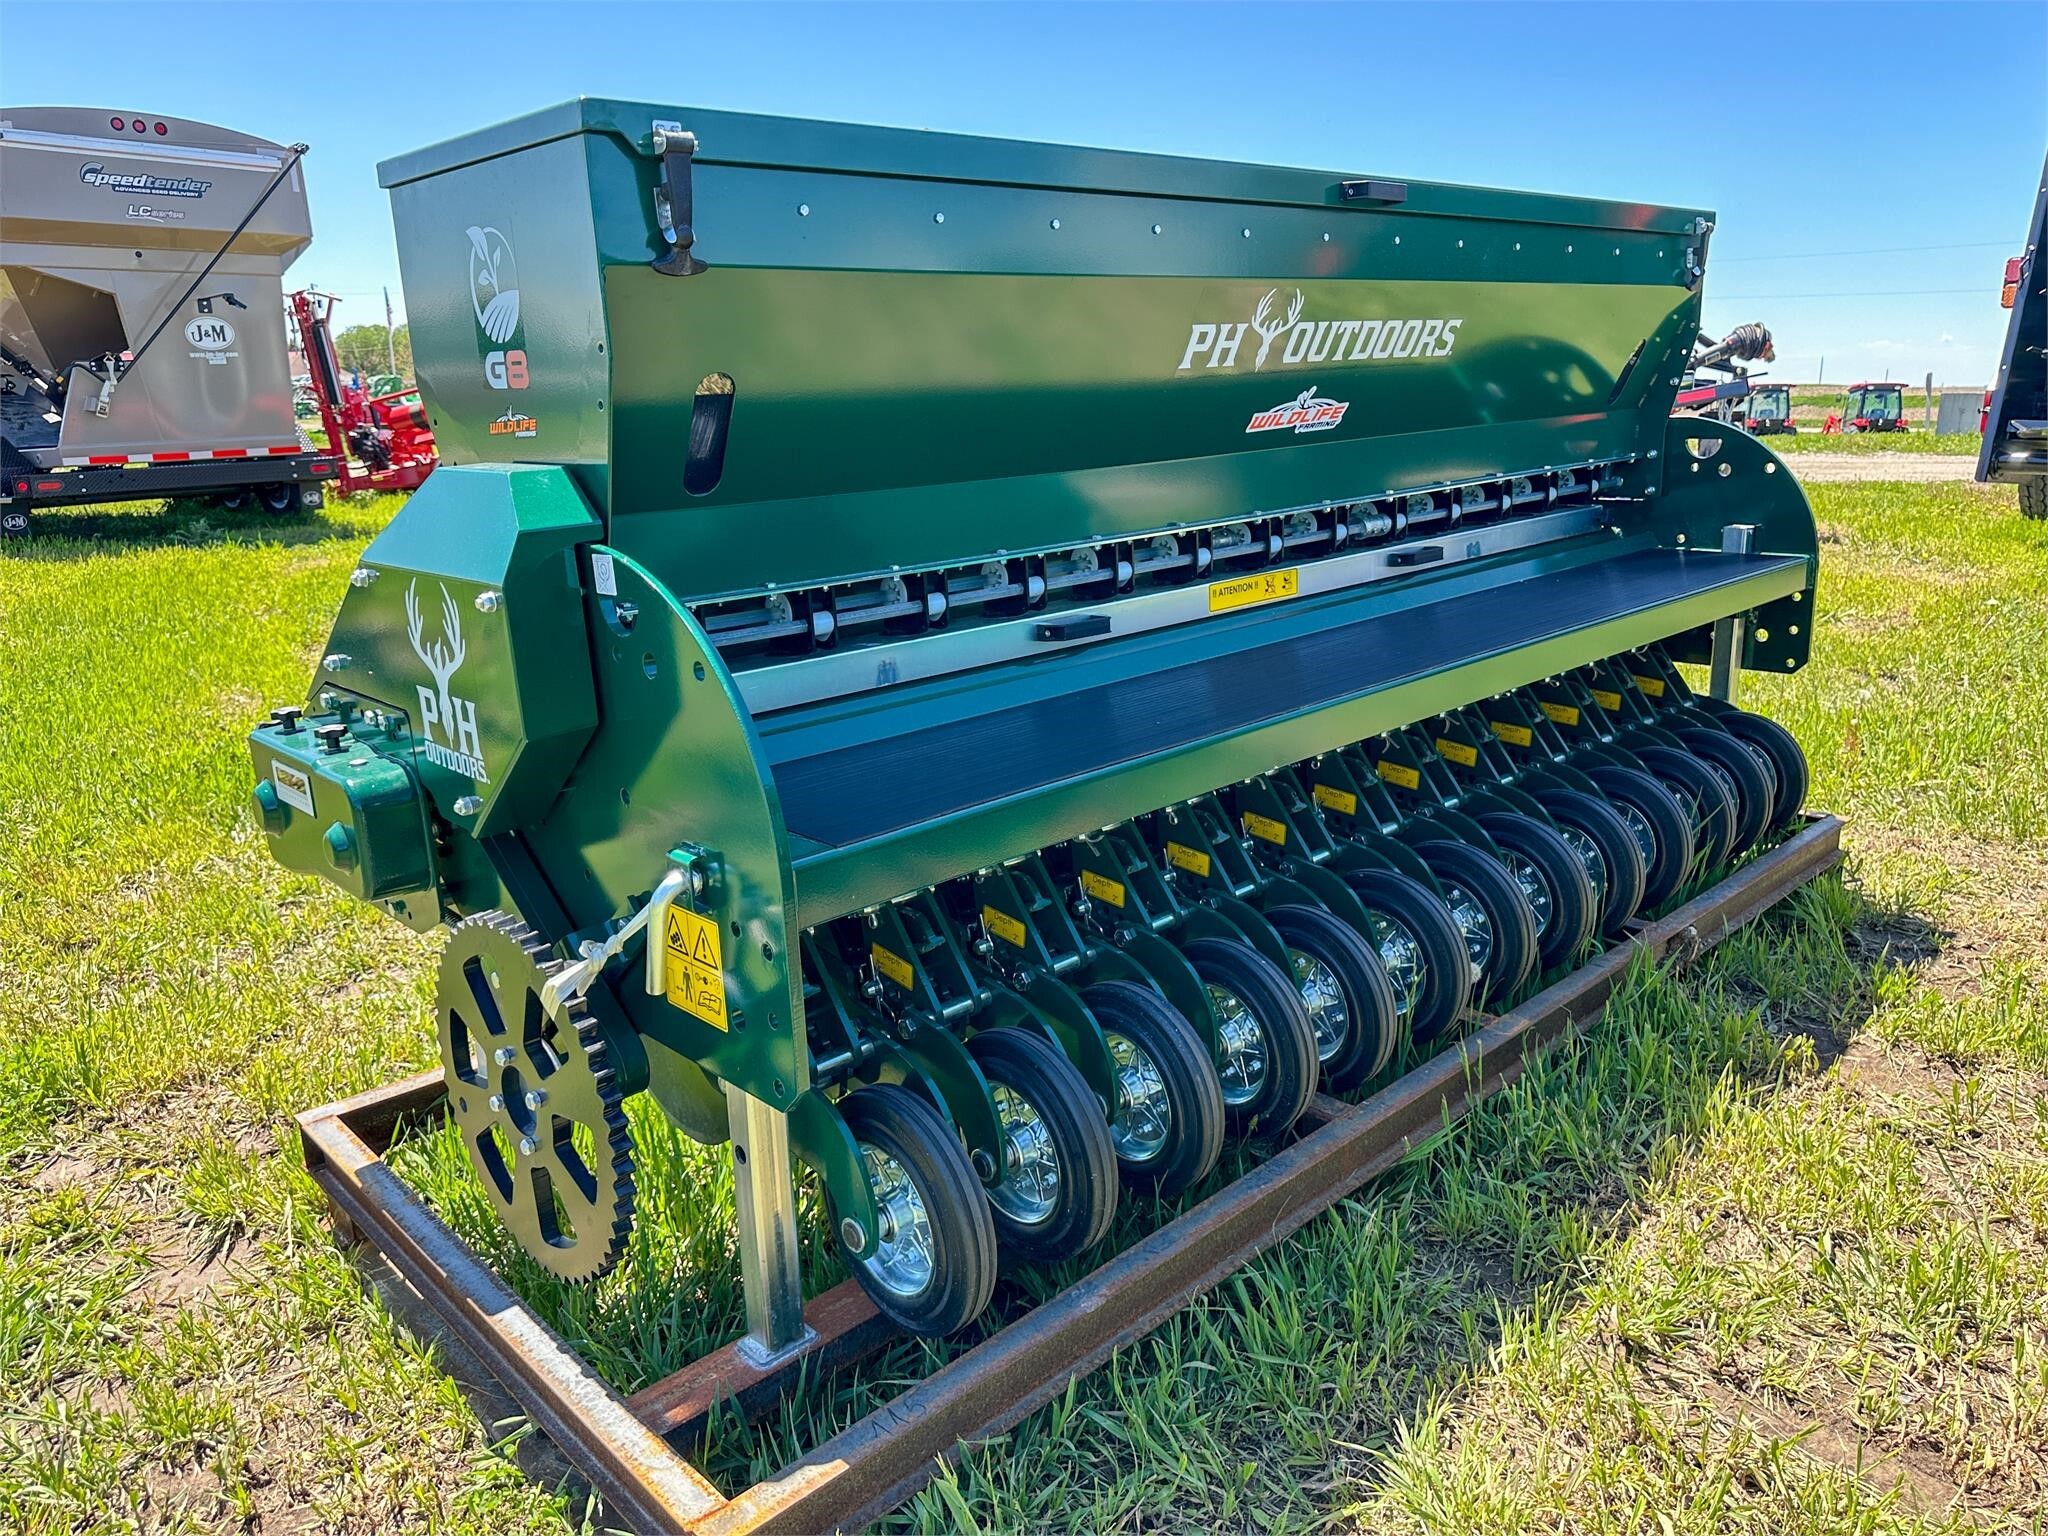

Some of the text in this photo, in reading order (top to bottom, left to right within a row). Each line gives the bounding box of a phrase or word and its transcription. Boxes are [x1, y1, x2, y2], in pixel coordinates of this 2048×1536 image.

[114, 186, 151, 194] ADVANCED
[190, 324, 228, 343] J&M
[1178, 322, 1250, 370] PH
[485, 350, 529, 389] G8
[1248, 406, 1346, 430] WILDLIFE
[1297, 420, 1337, 430] FARMING
[490, 419, 537, 434] WILDLIFE
[1218, 583, 1253, 597] ATTENTION
[1325, 787, 1345, 800] Depth
[1254, 816, 1275, 829] Depth
[1092, 875, 1113, 889] Depth
